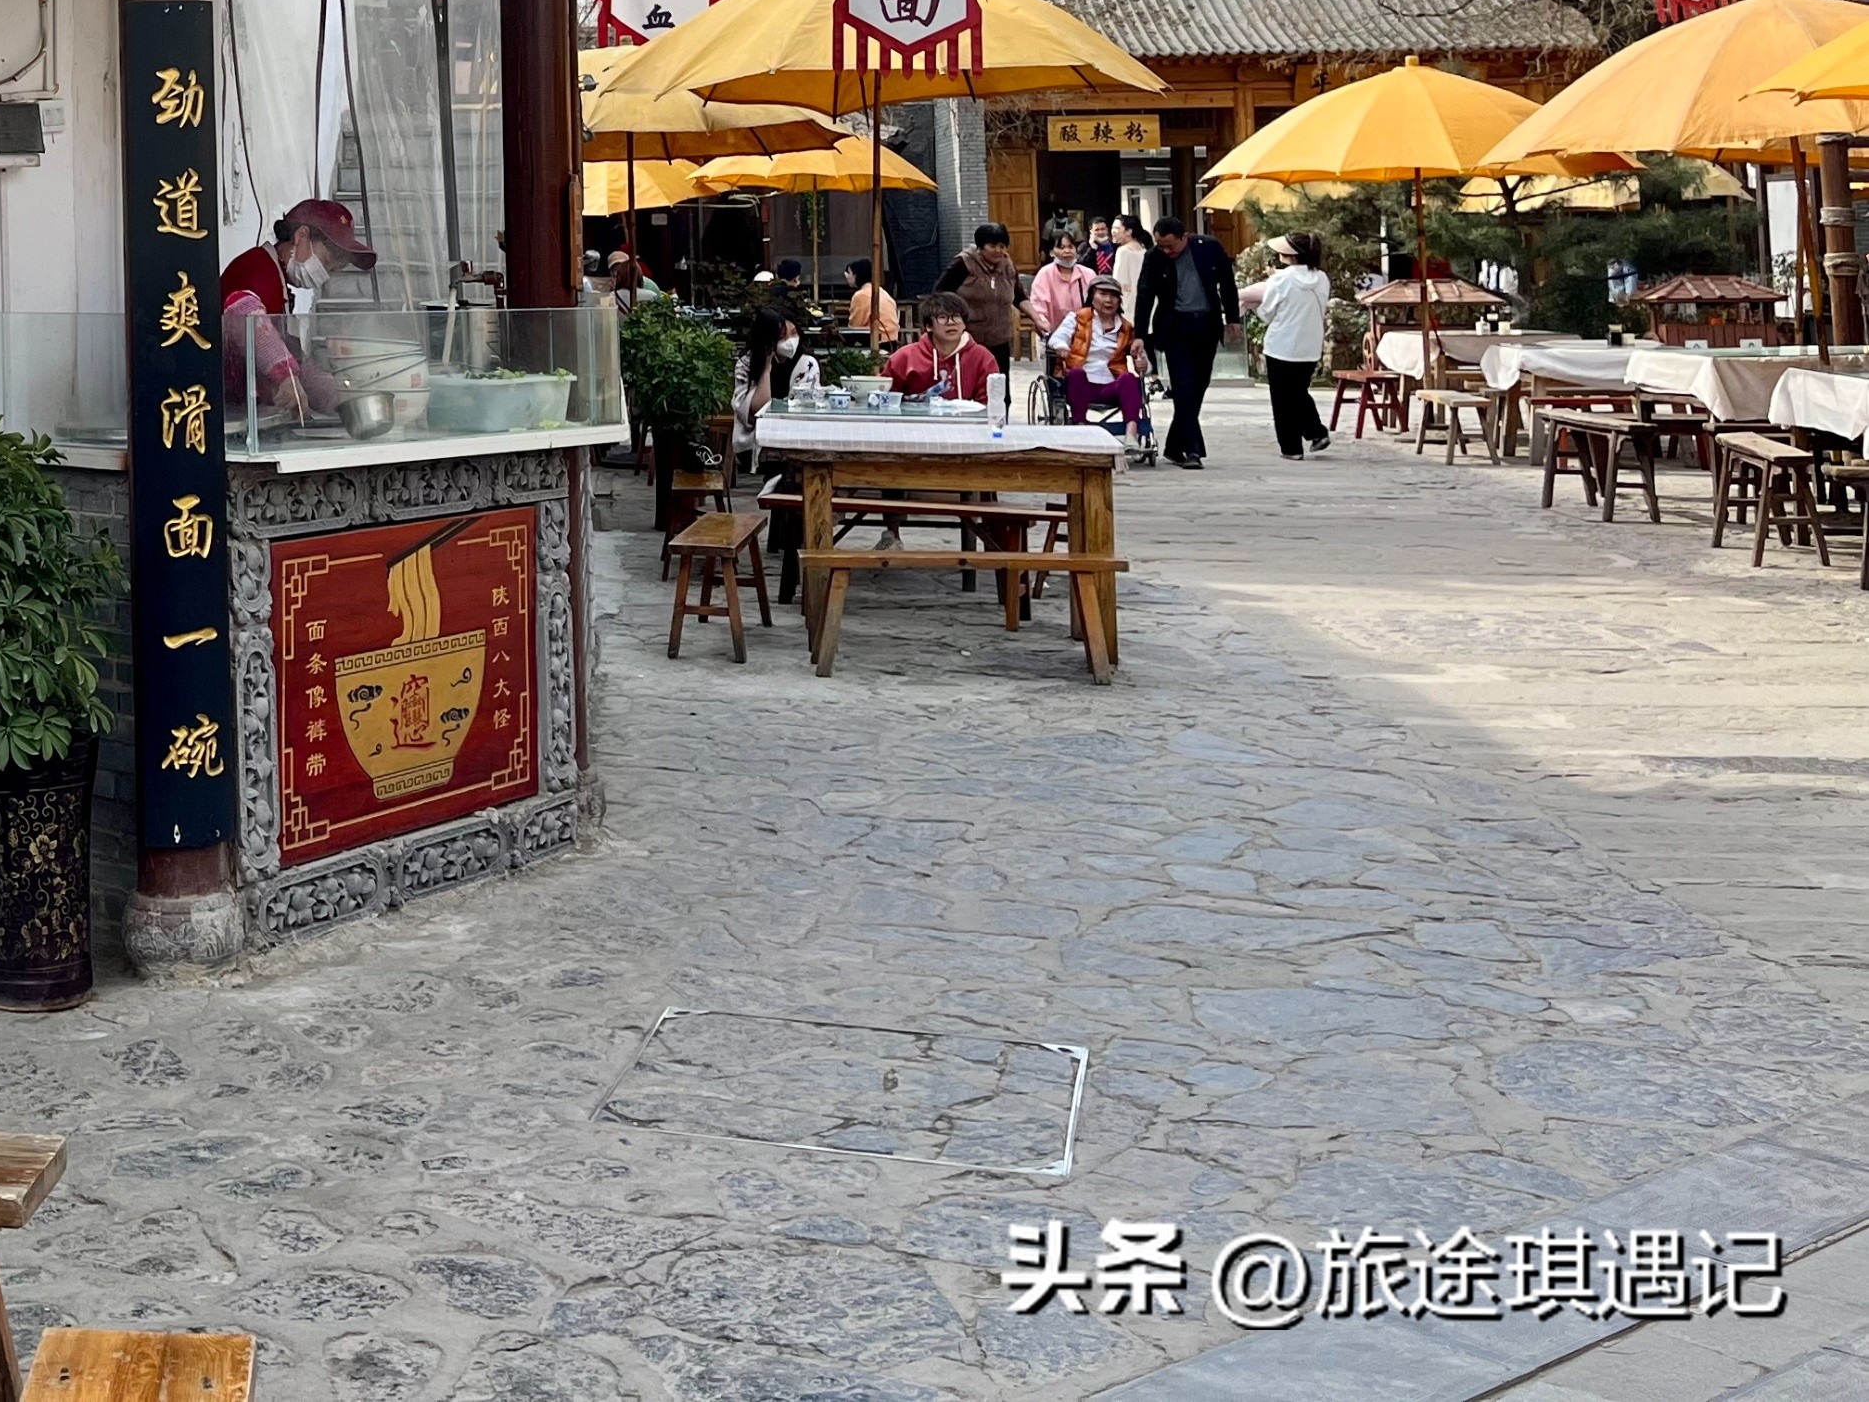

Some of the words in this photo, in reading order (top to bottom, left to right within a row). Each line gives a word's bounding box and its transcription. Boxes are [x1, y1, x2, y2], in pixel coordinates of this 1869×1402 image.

[1060, 119, 1148, 144] 酸辣粉
[151, 66, 224, 780] 劲道爽滑面一碗
[305, 618, 327, 777] 面条像裤带
[492, 585, 512, 730] 陕西八大怪
